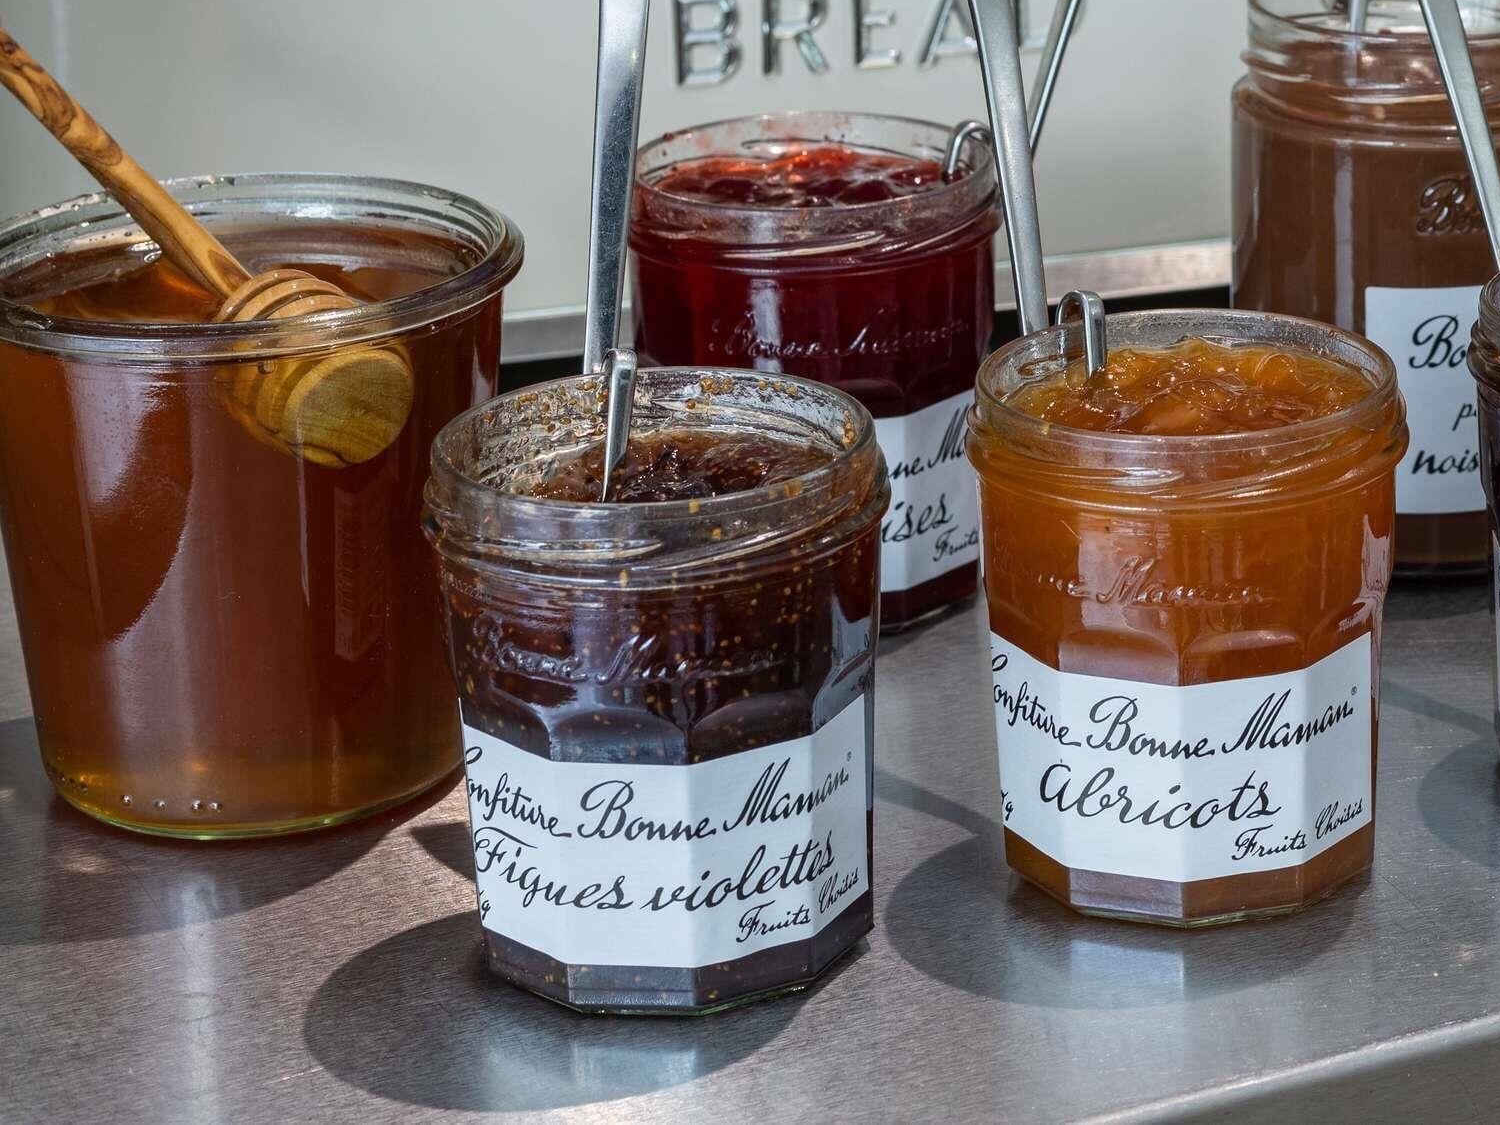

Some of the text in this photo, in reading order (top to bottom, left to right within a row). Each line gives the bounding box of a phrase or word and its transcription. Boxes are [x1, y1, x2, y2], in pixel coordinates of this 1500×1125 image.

[1086, 695, 1216, 760] Bonne
[577, 780, 717, 842] Bonne
[1039, 762, 1282, 829] Abricots
[1231, 798, 1363, 861] Fruits Choisis
[474, 826, 836, 912] Figues violettes
[736, 867, 859, 943] Fruits Choisis
